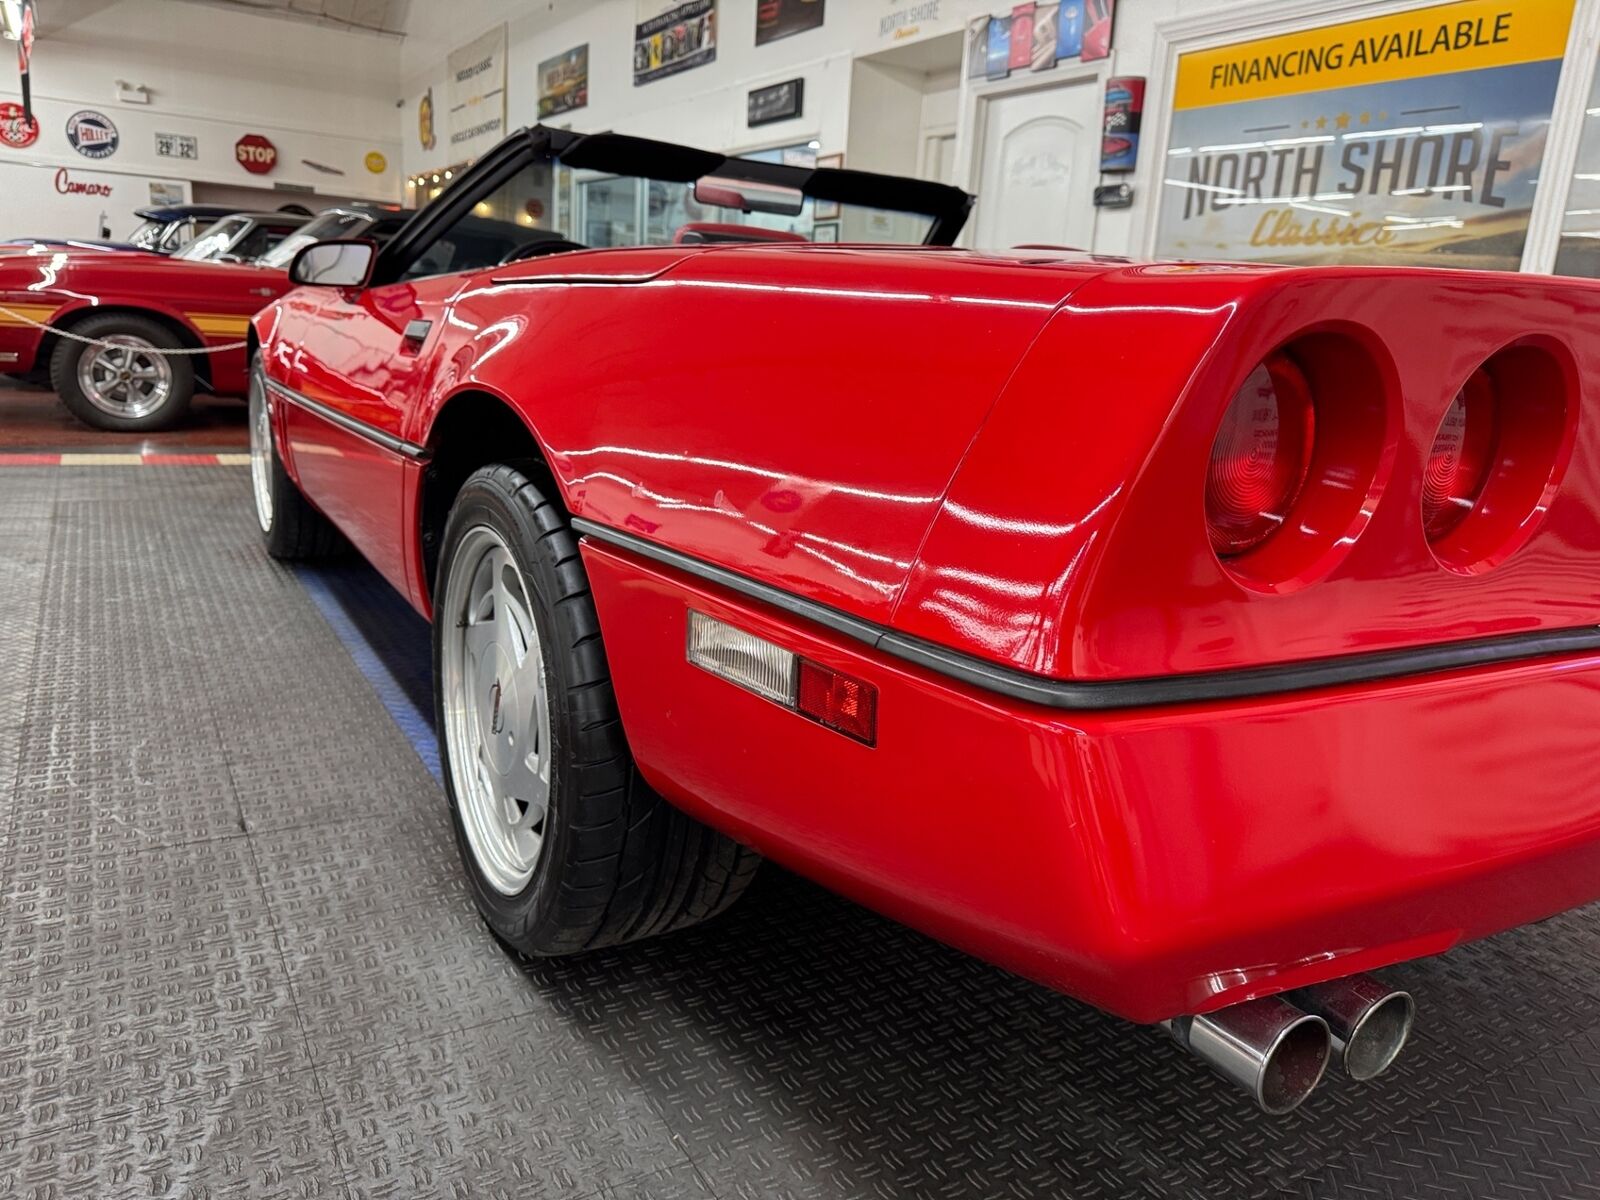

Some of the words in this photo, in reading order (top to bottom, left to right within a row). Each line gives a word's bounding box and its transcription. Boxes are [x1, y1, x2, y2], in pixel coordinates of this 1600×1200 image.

[1210, 43, 1343, 89] FINANCING
[1349, 12, 1512, 68] AVAILABLE
[237, 144, 276, 164] STOP
[1182, 140, 1323, 220] NORTH
[1337, 124, 1520, 209] SHORE
[55, 166, 113, 197] Camaro
[1249, 207, 1399, 249] Classics
